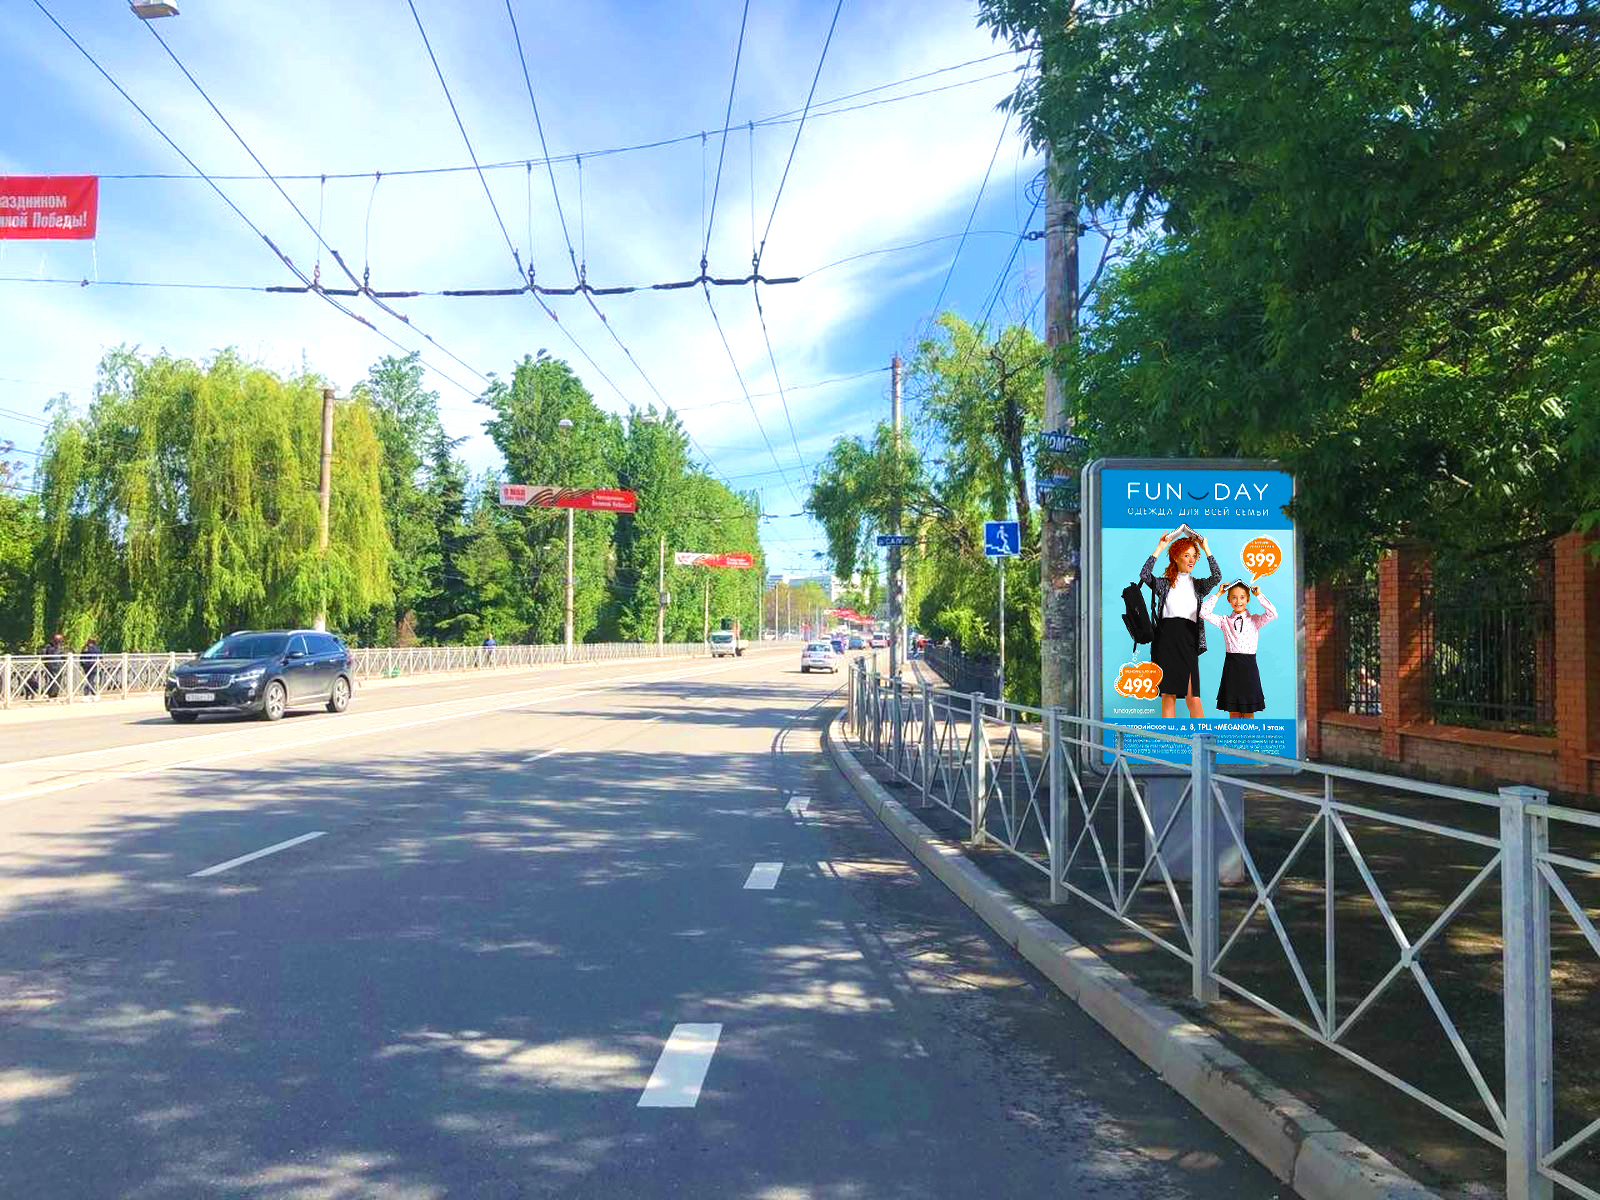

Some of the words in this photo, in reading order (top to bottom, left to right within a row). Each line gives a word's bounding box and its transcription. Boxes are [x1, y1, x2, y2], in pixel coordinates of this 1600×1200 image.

[32, 211, 87, 230] Победы!
[1127, 482, 1182, 501] FUN
[1214, 482, 1269, 501] DAY
[1127, 507, 1173, 517] ОДЕЖДА
[1178, 508, 1199, 517] ДЛЯ
[1204, 506, 1230, 517] ВСЕЙ
[1235, 508, 1270, 517] СЕМЬИ
[1245, 552, 1278, 568] 399.
[1123, 678, 1155, 693] 499.
[1197, 723, 1213, 732] ТРЦ
[1213, 723, 1261, 732] «MEGANOM»,
